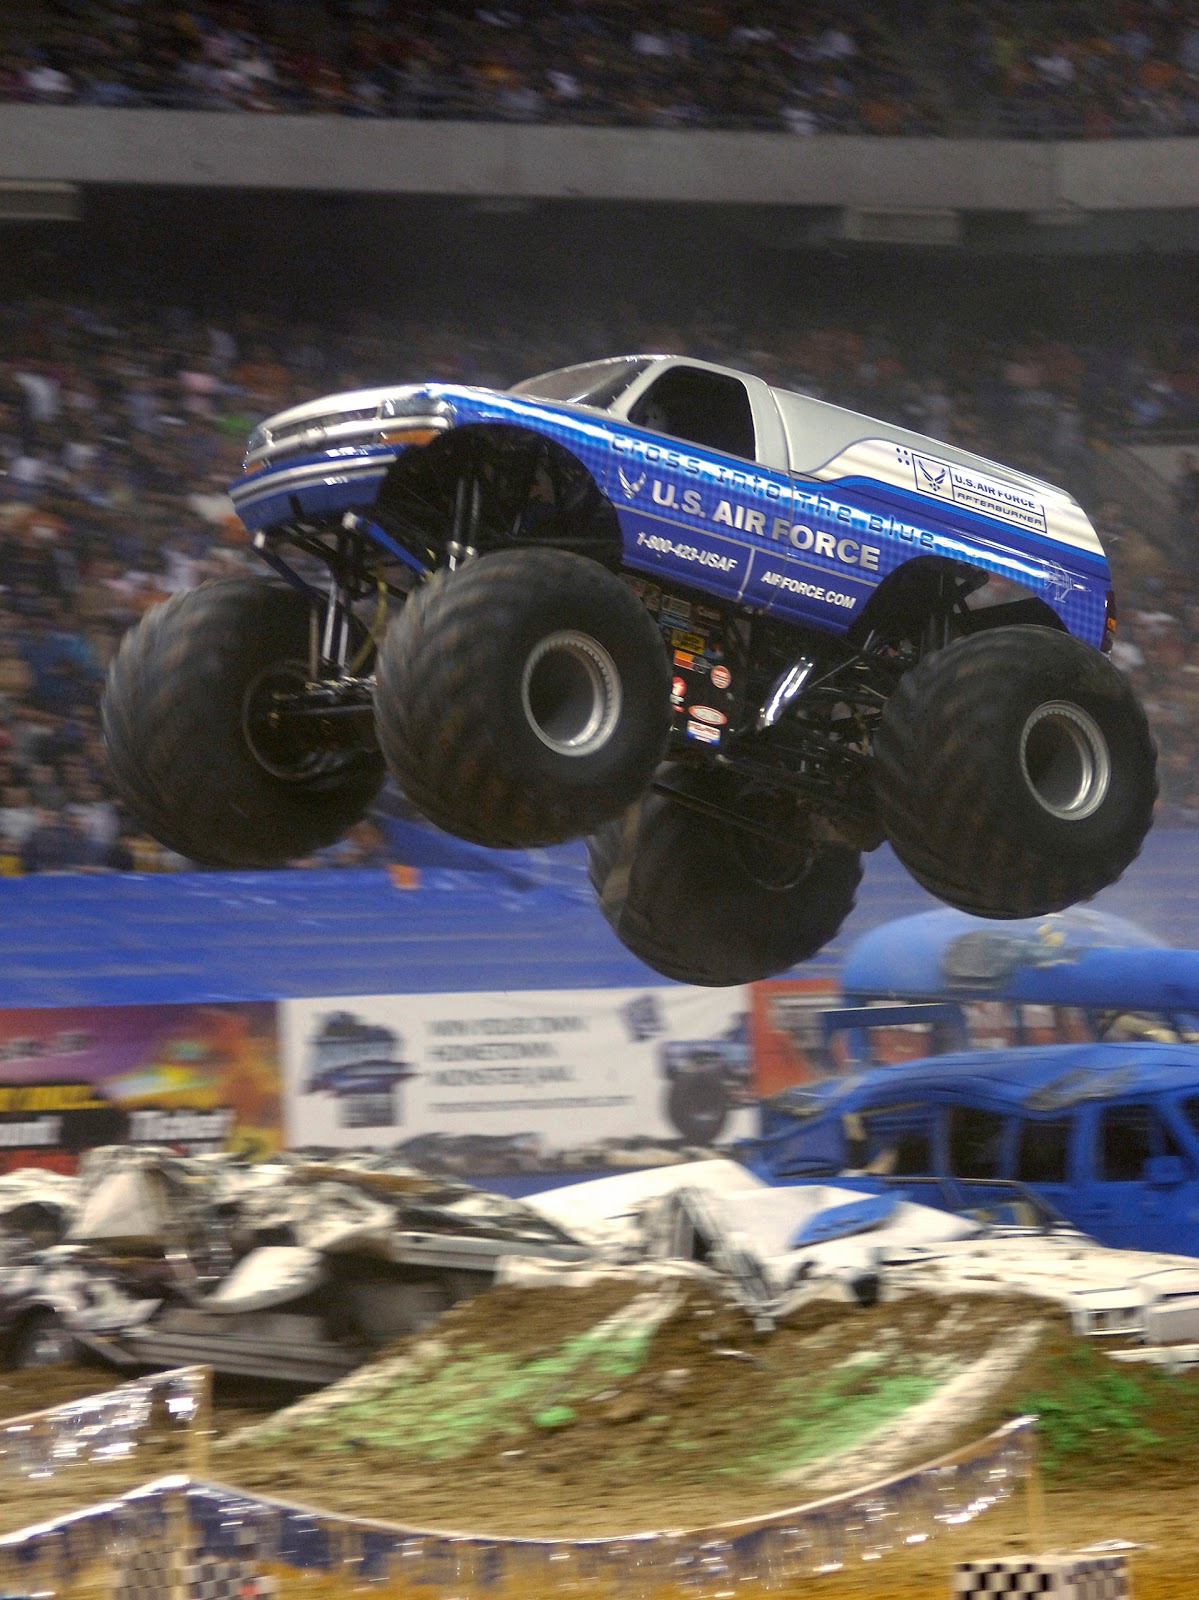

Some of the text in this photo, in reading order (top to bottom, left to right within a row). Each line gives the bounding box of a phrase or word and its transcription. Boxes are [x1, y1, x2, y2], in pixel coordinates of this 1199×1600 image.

[954, 474, 1036, 509] U.S. AIR FORCE
[957, 492, 1043, 526] AFTERBURNER
[652, 480, 881, 571] U.S. AIR FORCE
[636, 531, 738, 573] 1-800-423-USAF
[760, 570, 857, 610] AIRFORCE.COM
